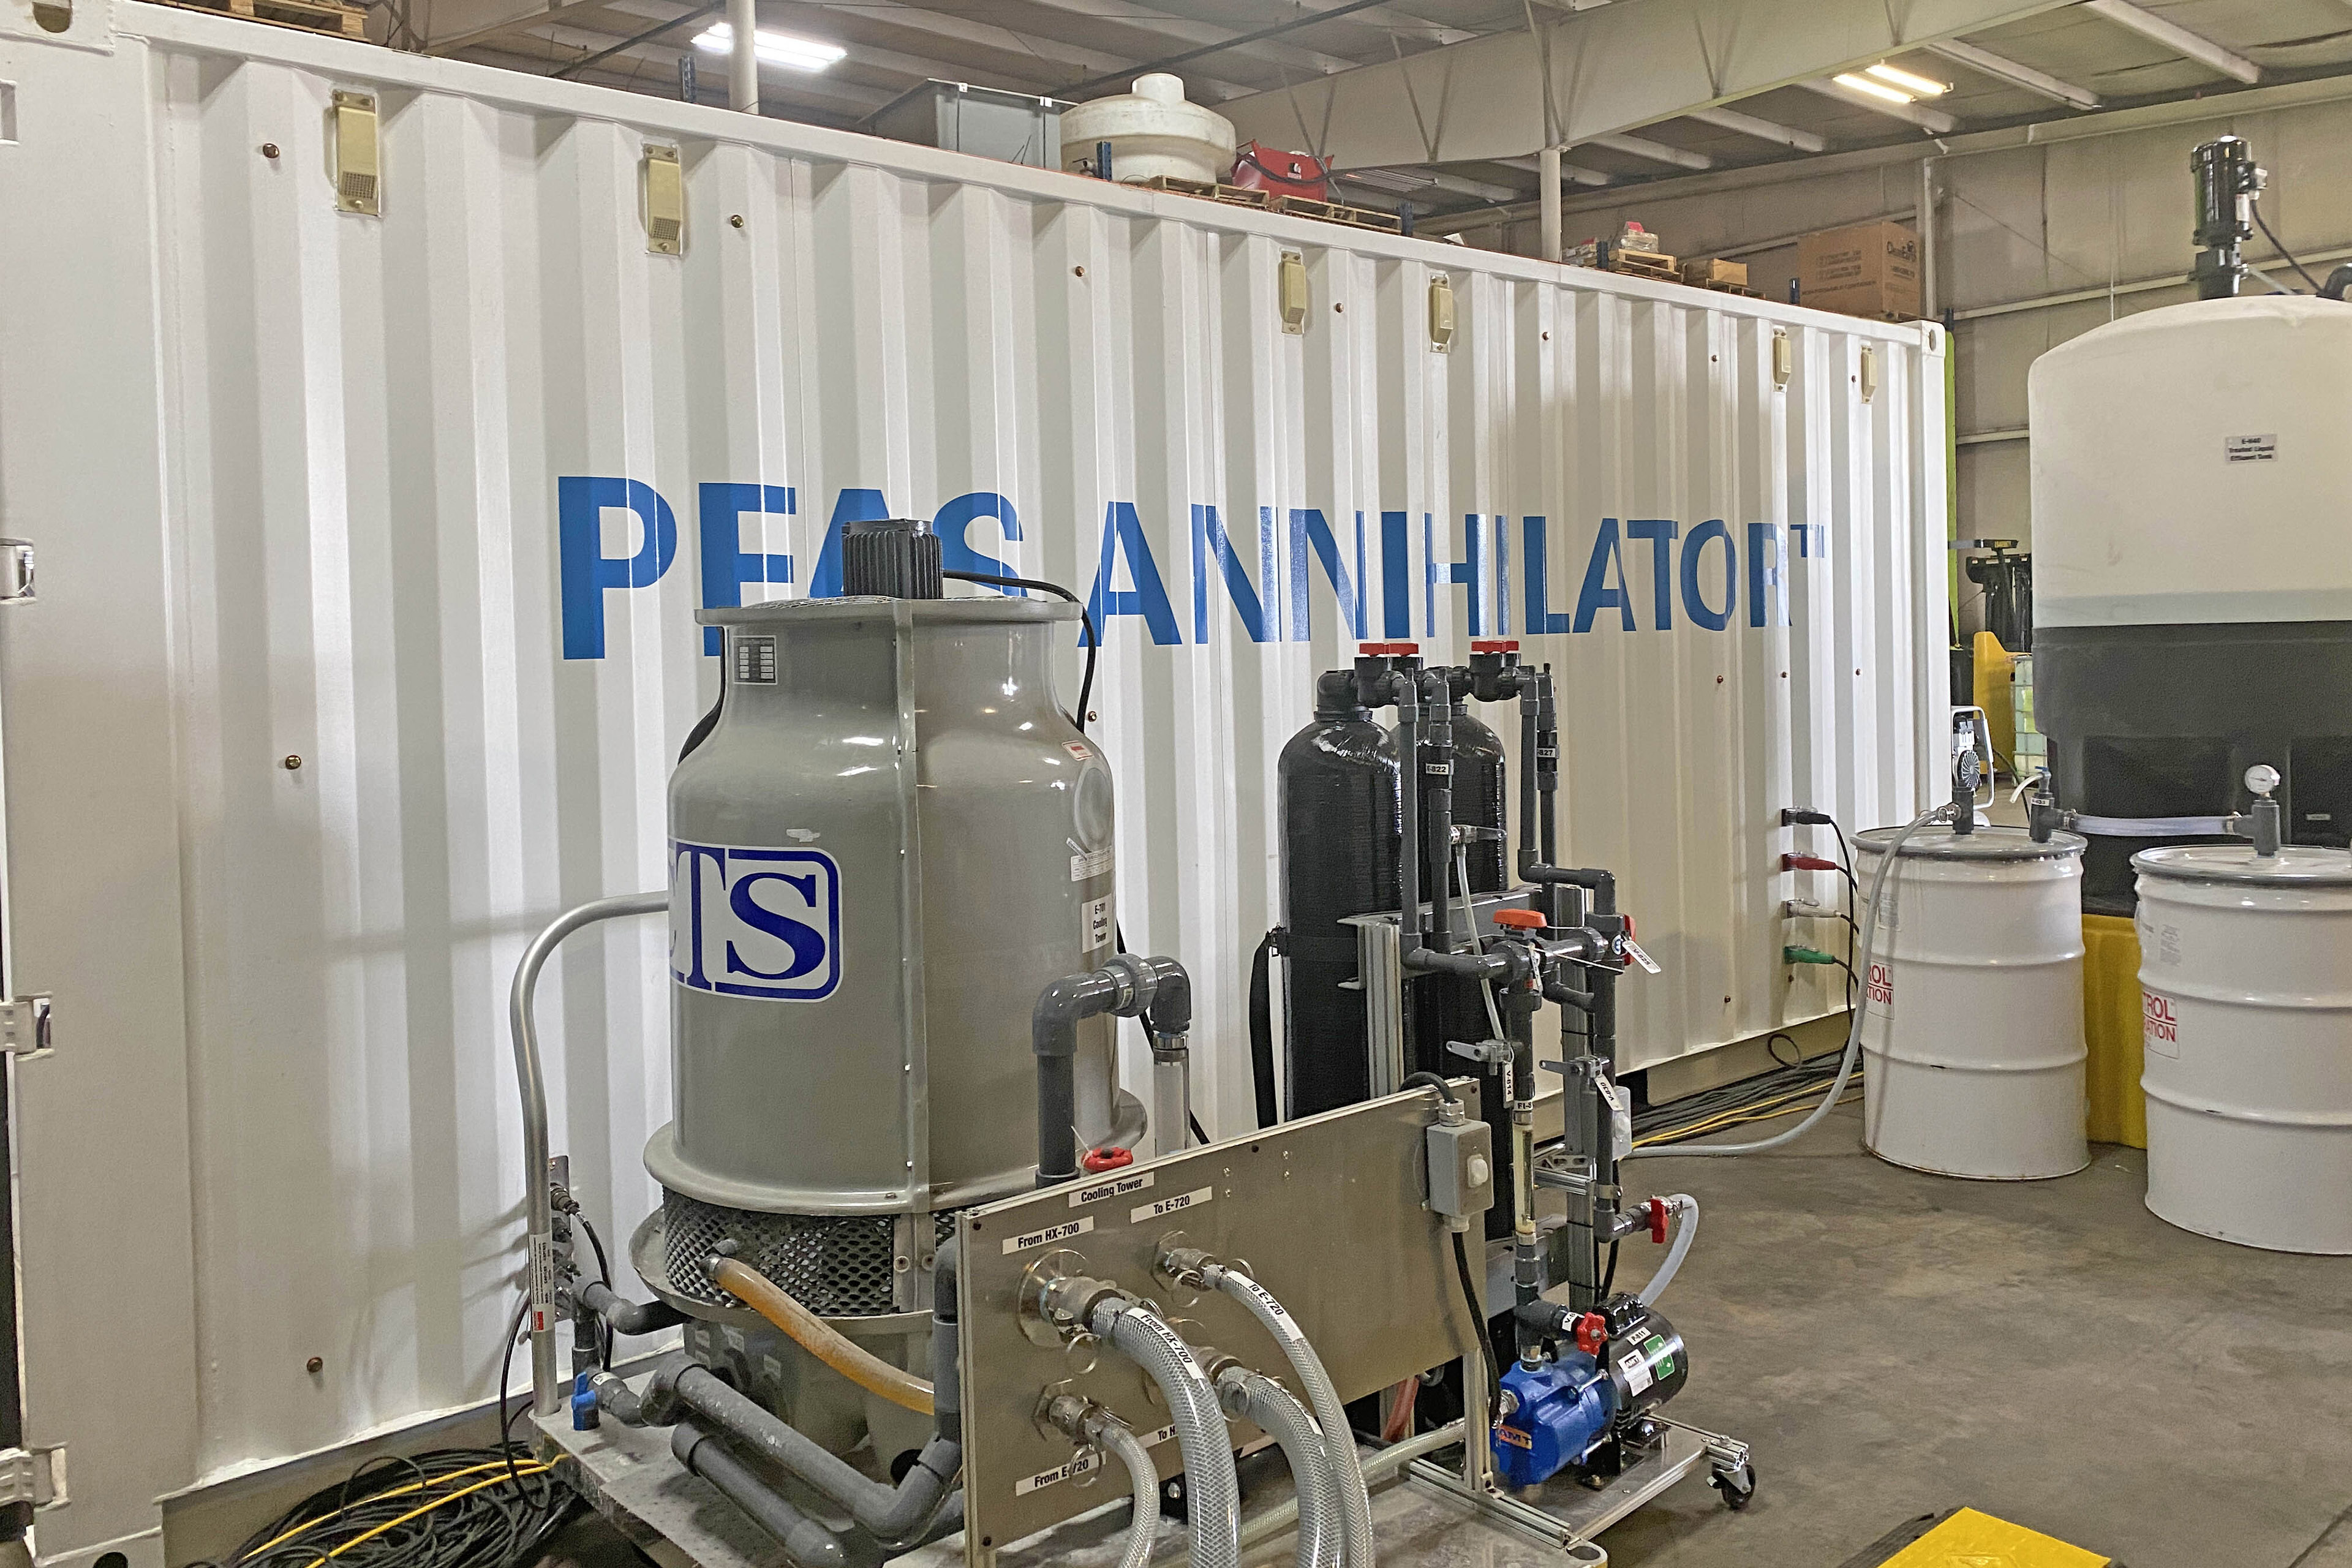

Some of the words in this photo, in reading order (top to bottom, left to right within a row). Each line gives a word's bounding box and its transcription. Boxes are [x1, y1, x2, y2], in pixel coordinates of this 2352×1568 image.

[668, 842, 826, 992] TS
[1080, 1186, 1115, 1202] Cooling
[1116, 1178, 1143, 1193] Tower
[1153, 1204, 1163, 1215] To
[1166, 1195, 1190, 1212] E-720
[1017, 1234, 1042, 1248] From
[1045, 1222, 1079, 1241] HX-700
[1248, 1283, 1261, 1292] To
[1258, 1292, 1284, 1315] E-720
[1140, 1314, 1165, 1332] From
[1161, 1332, 1193, 1363] HX-700
[1157, 1430, 1167, 1441] To
[1034, 1471, 1059, 1488] From
